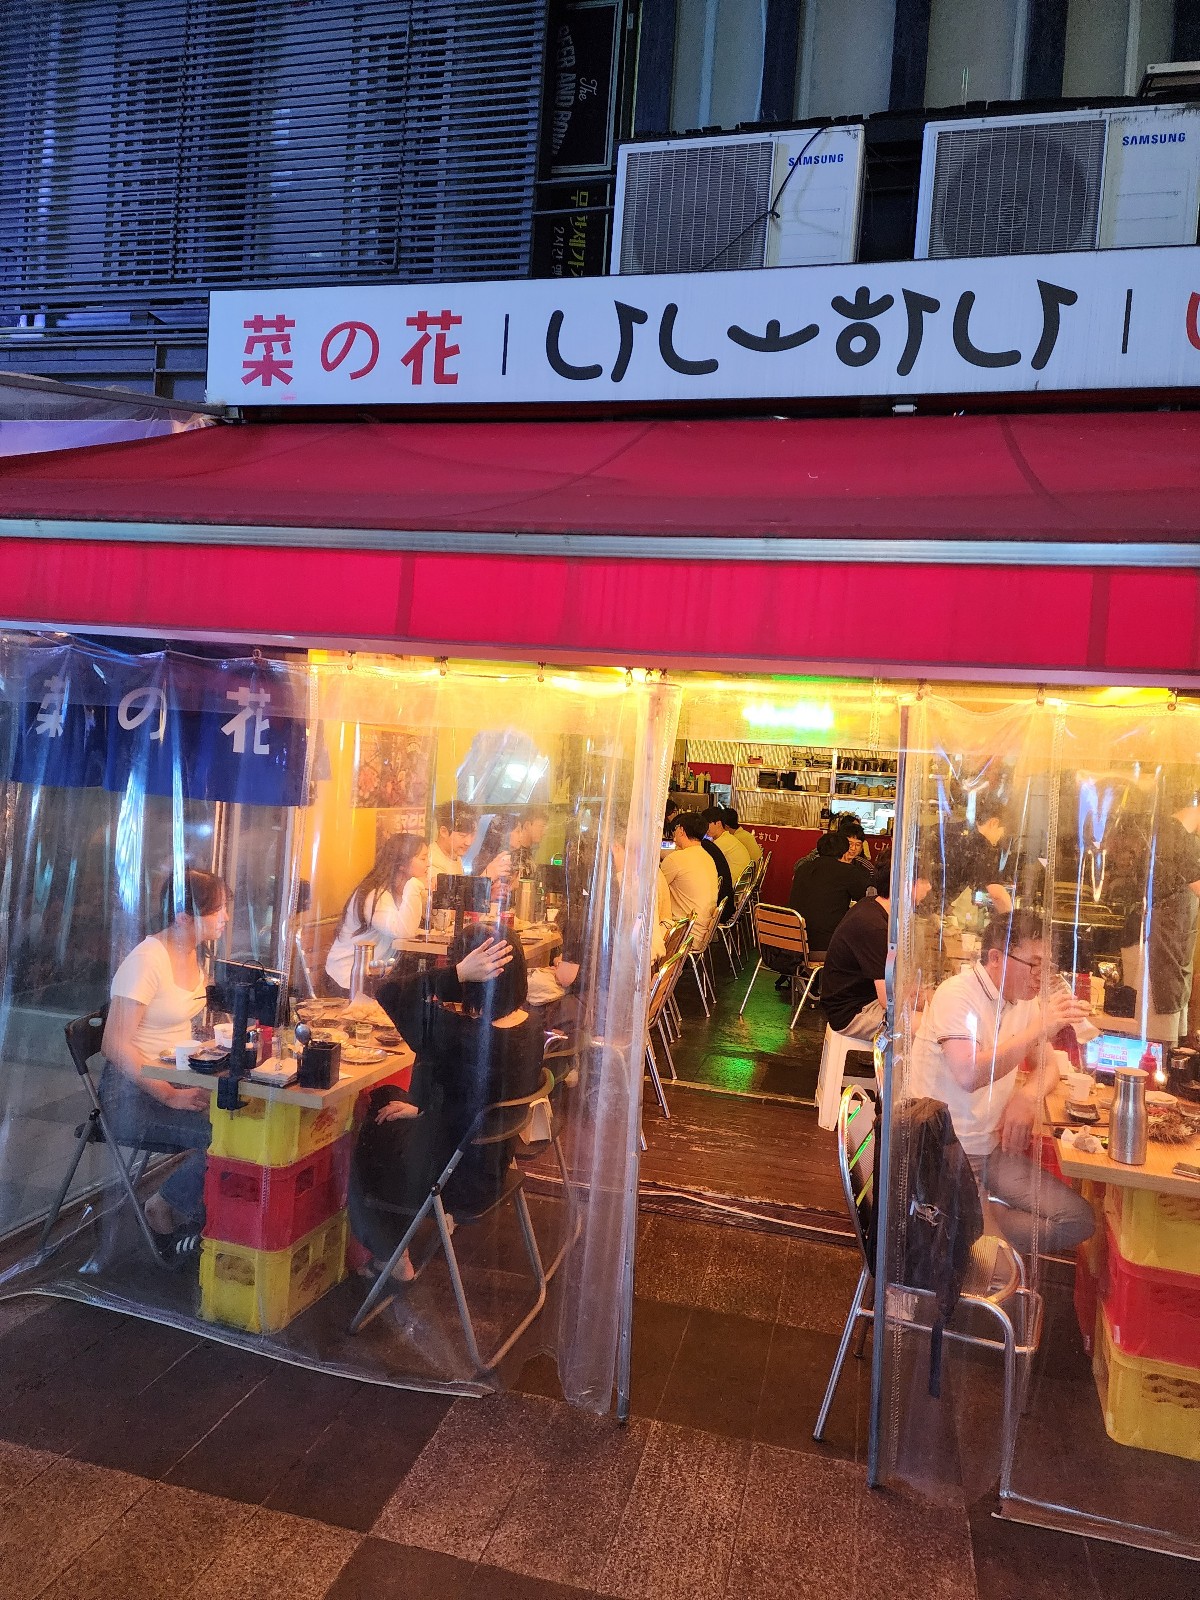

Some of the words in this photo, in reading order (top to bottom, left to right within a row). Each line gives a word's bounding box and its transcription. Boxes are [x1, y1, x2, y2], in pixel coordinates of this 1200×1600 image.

[555, 72, 577, 108] AND
[578, 77, 598, 101] The
[1122, 132, 1187, 146] SAMSUNG
[788, 153, 844, 167] SAMSUNG
[551, 226, 565, 259] 2시간
[545, 279, 1079, 383] 나노하나
[241, 309, 463, 387] 菜の花
[755, 831, 780, 843] 하나
